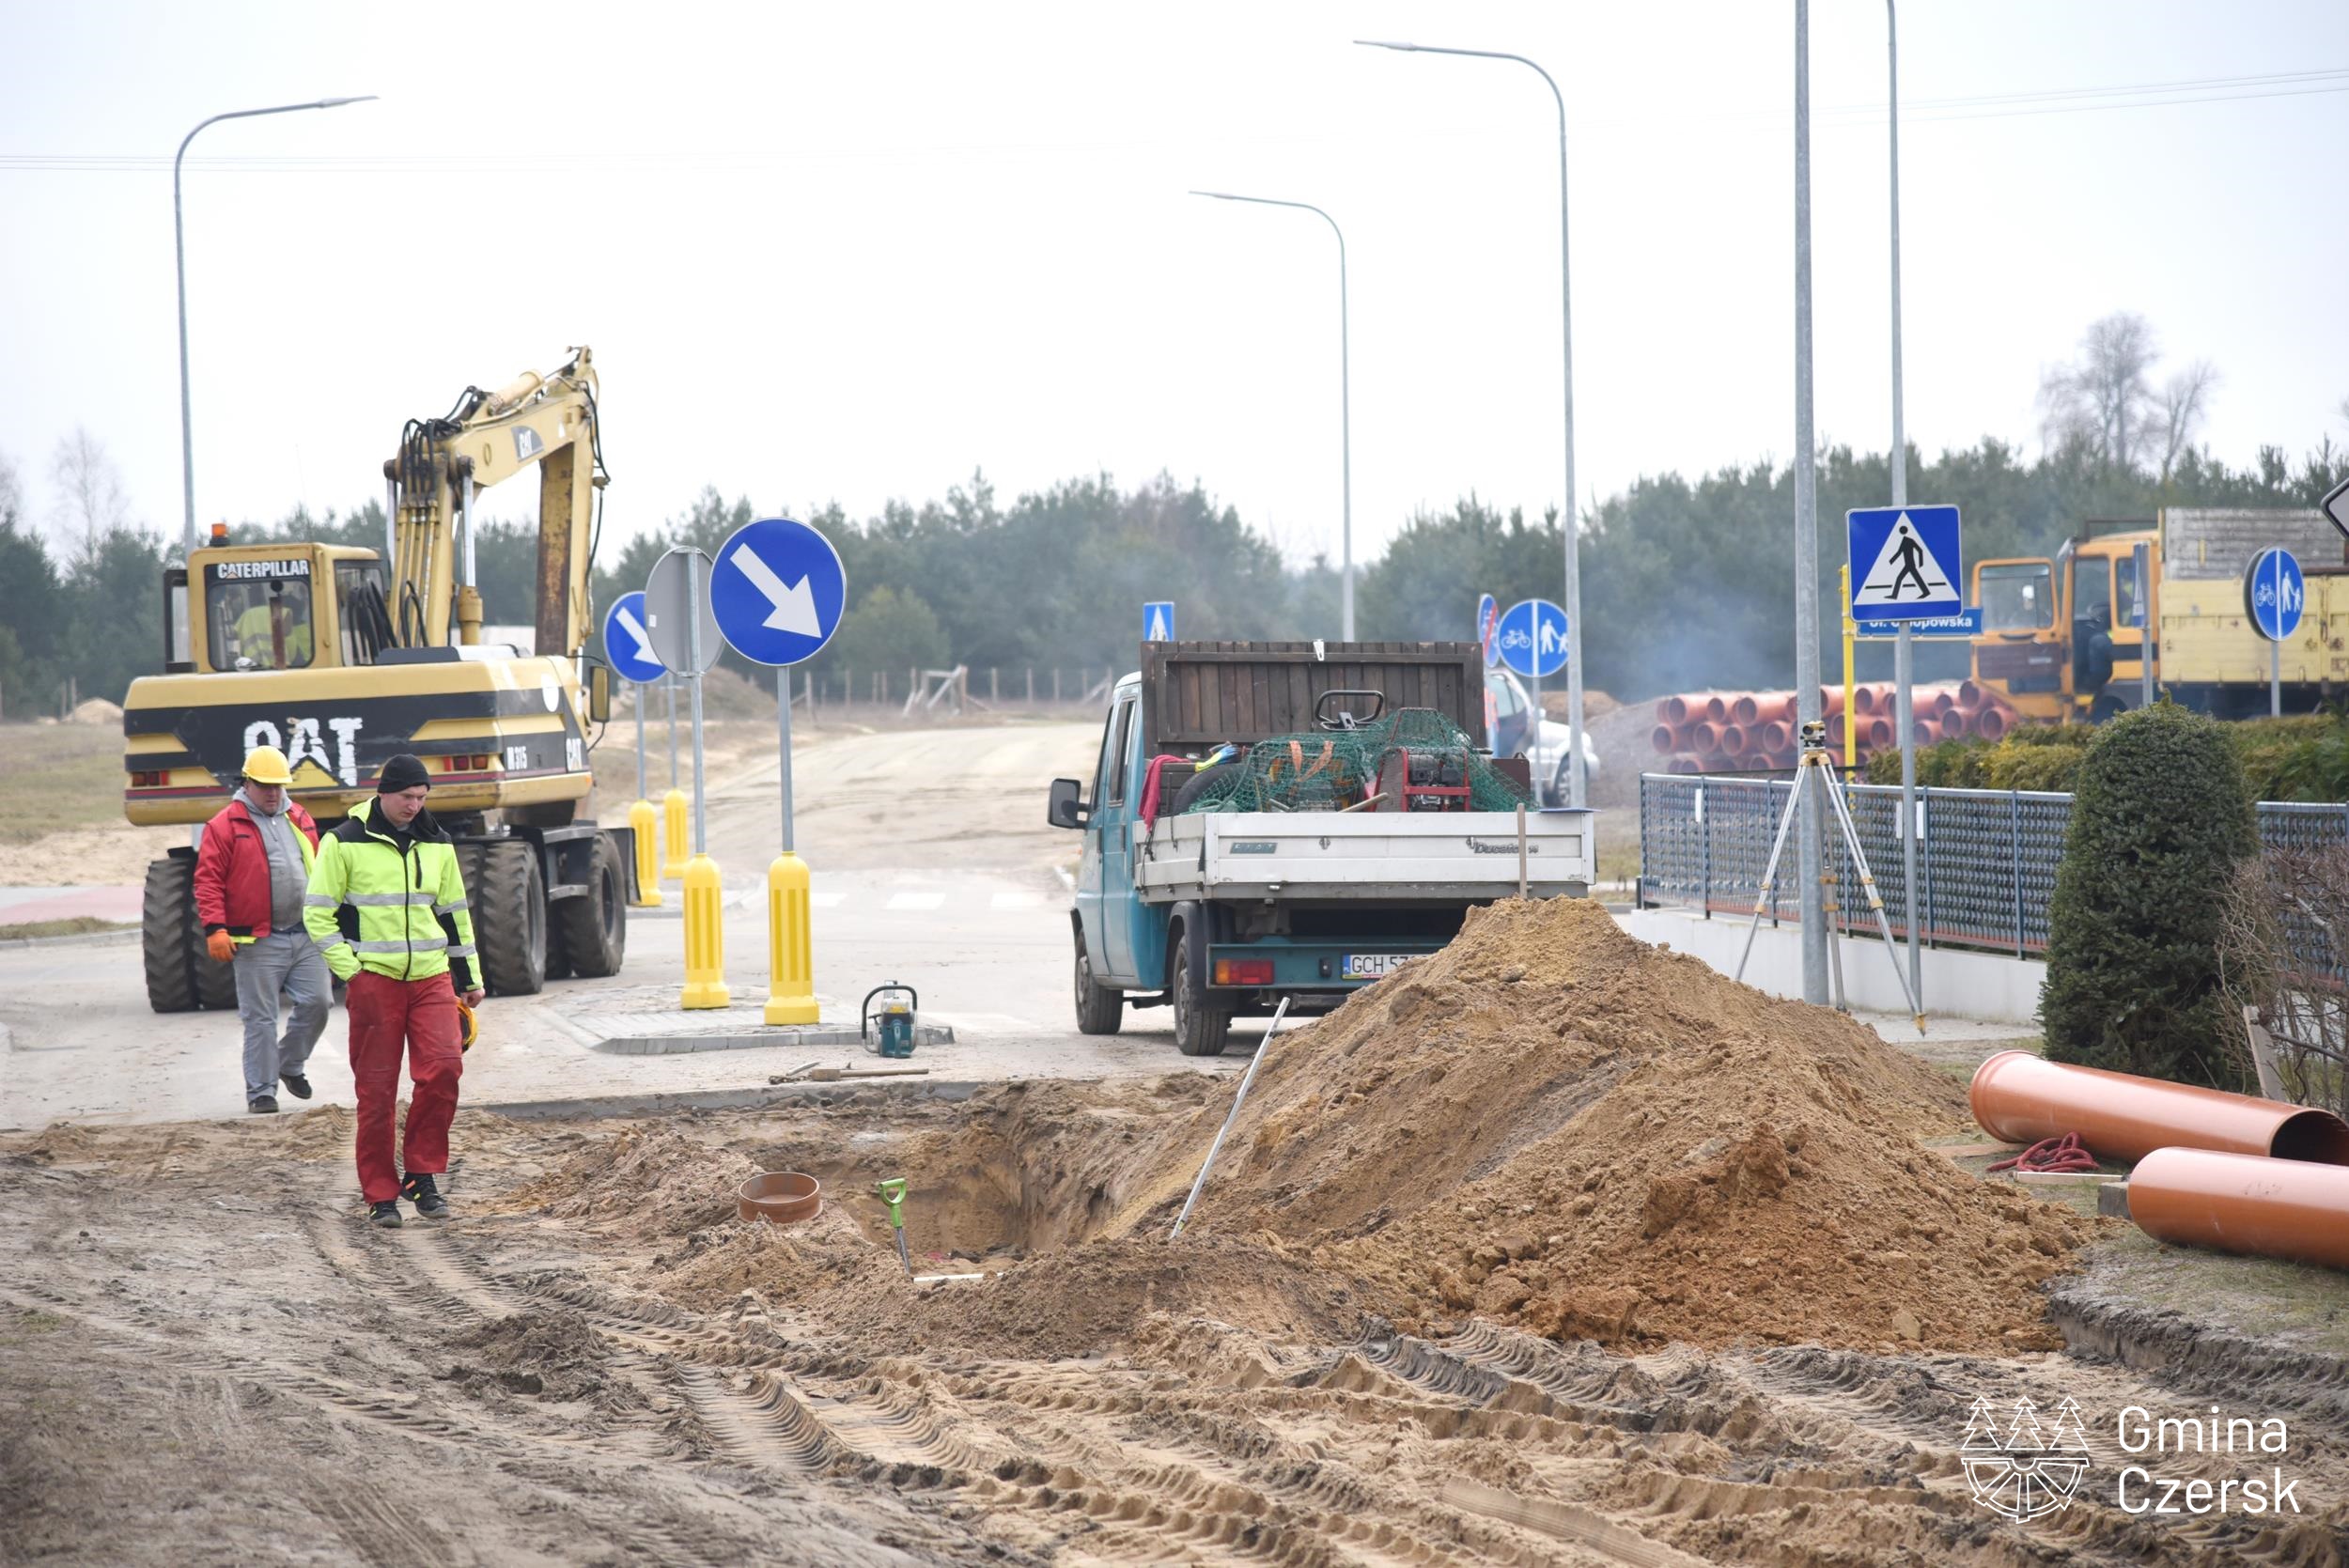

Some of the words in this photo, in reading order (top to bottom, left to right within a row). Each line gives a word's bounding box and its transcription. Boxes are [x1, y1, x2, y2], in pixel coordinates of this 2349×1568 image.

[519, 430, 533, 458] CAT
[218, 560, 309, 579] CATERPILLAR
[566, 737, 582, 771] CAT
[1352, 956, 1384, 973] GCH
